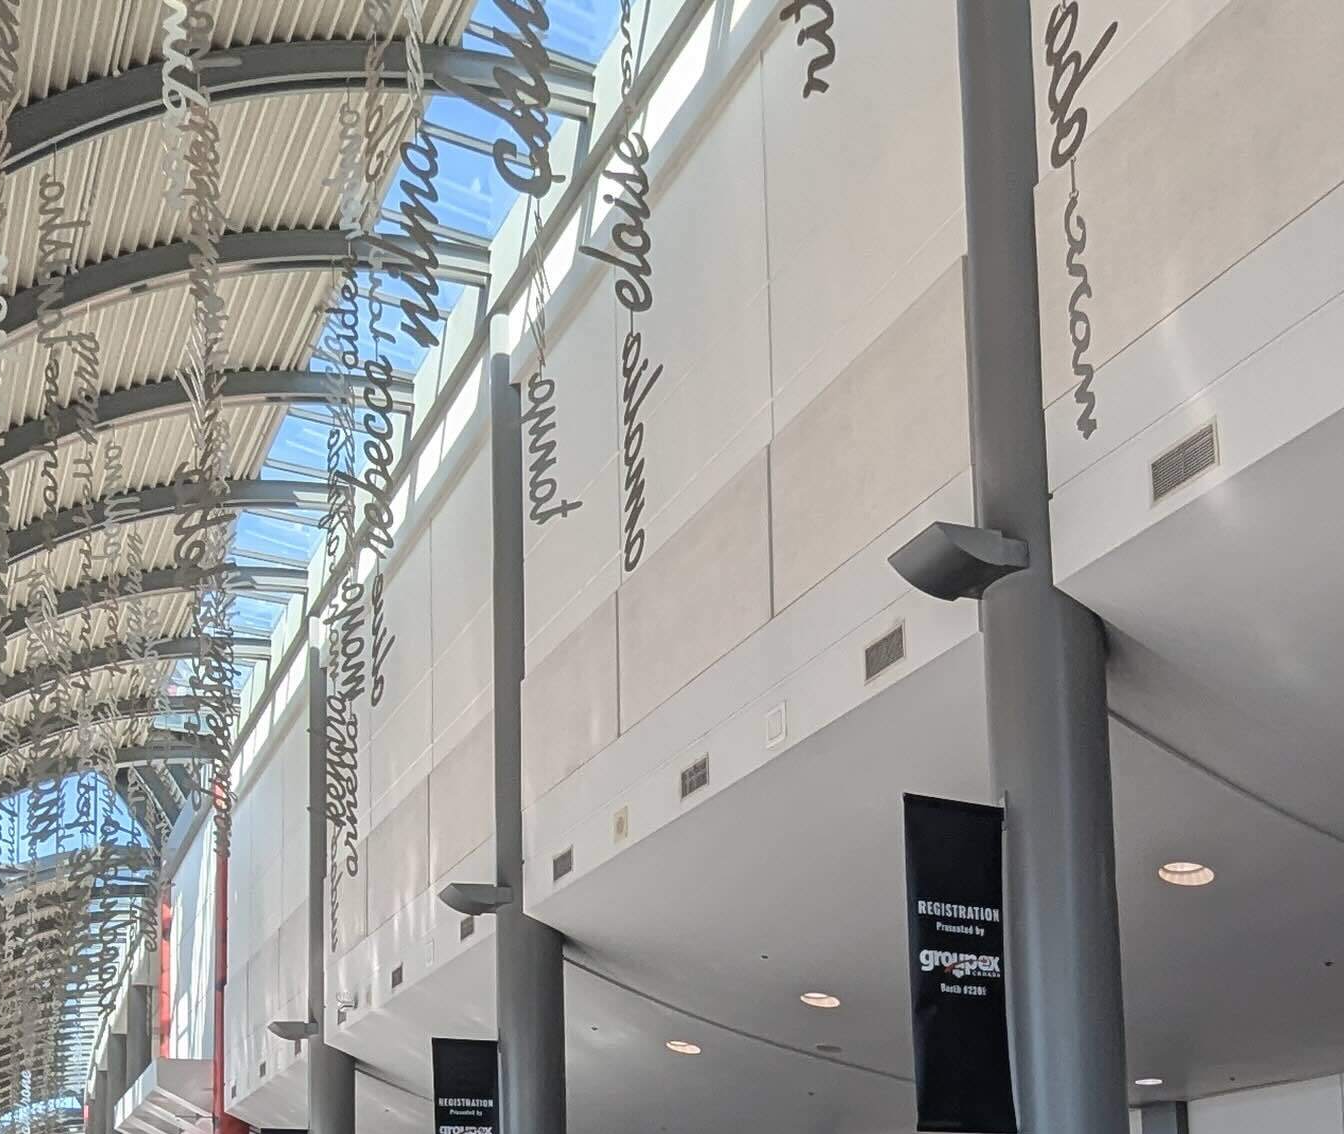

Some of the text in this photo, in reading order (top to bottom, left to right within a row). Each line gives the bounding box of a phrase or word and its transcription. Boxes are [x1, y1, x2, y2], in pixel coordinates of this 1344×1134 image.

[578, 133, 654, 312] eloise
[326, 252, 359, 368] aiden
[334, 355, 393, 559] rebecca
[918, 900, 999, 922] REGISTRATION
[976, 926, 984, 936] by
[439, 1098, 493, 1107] REGISTRATION
